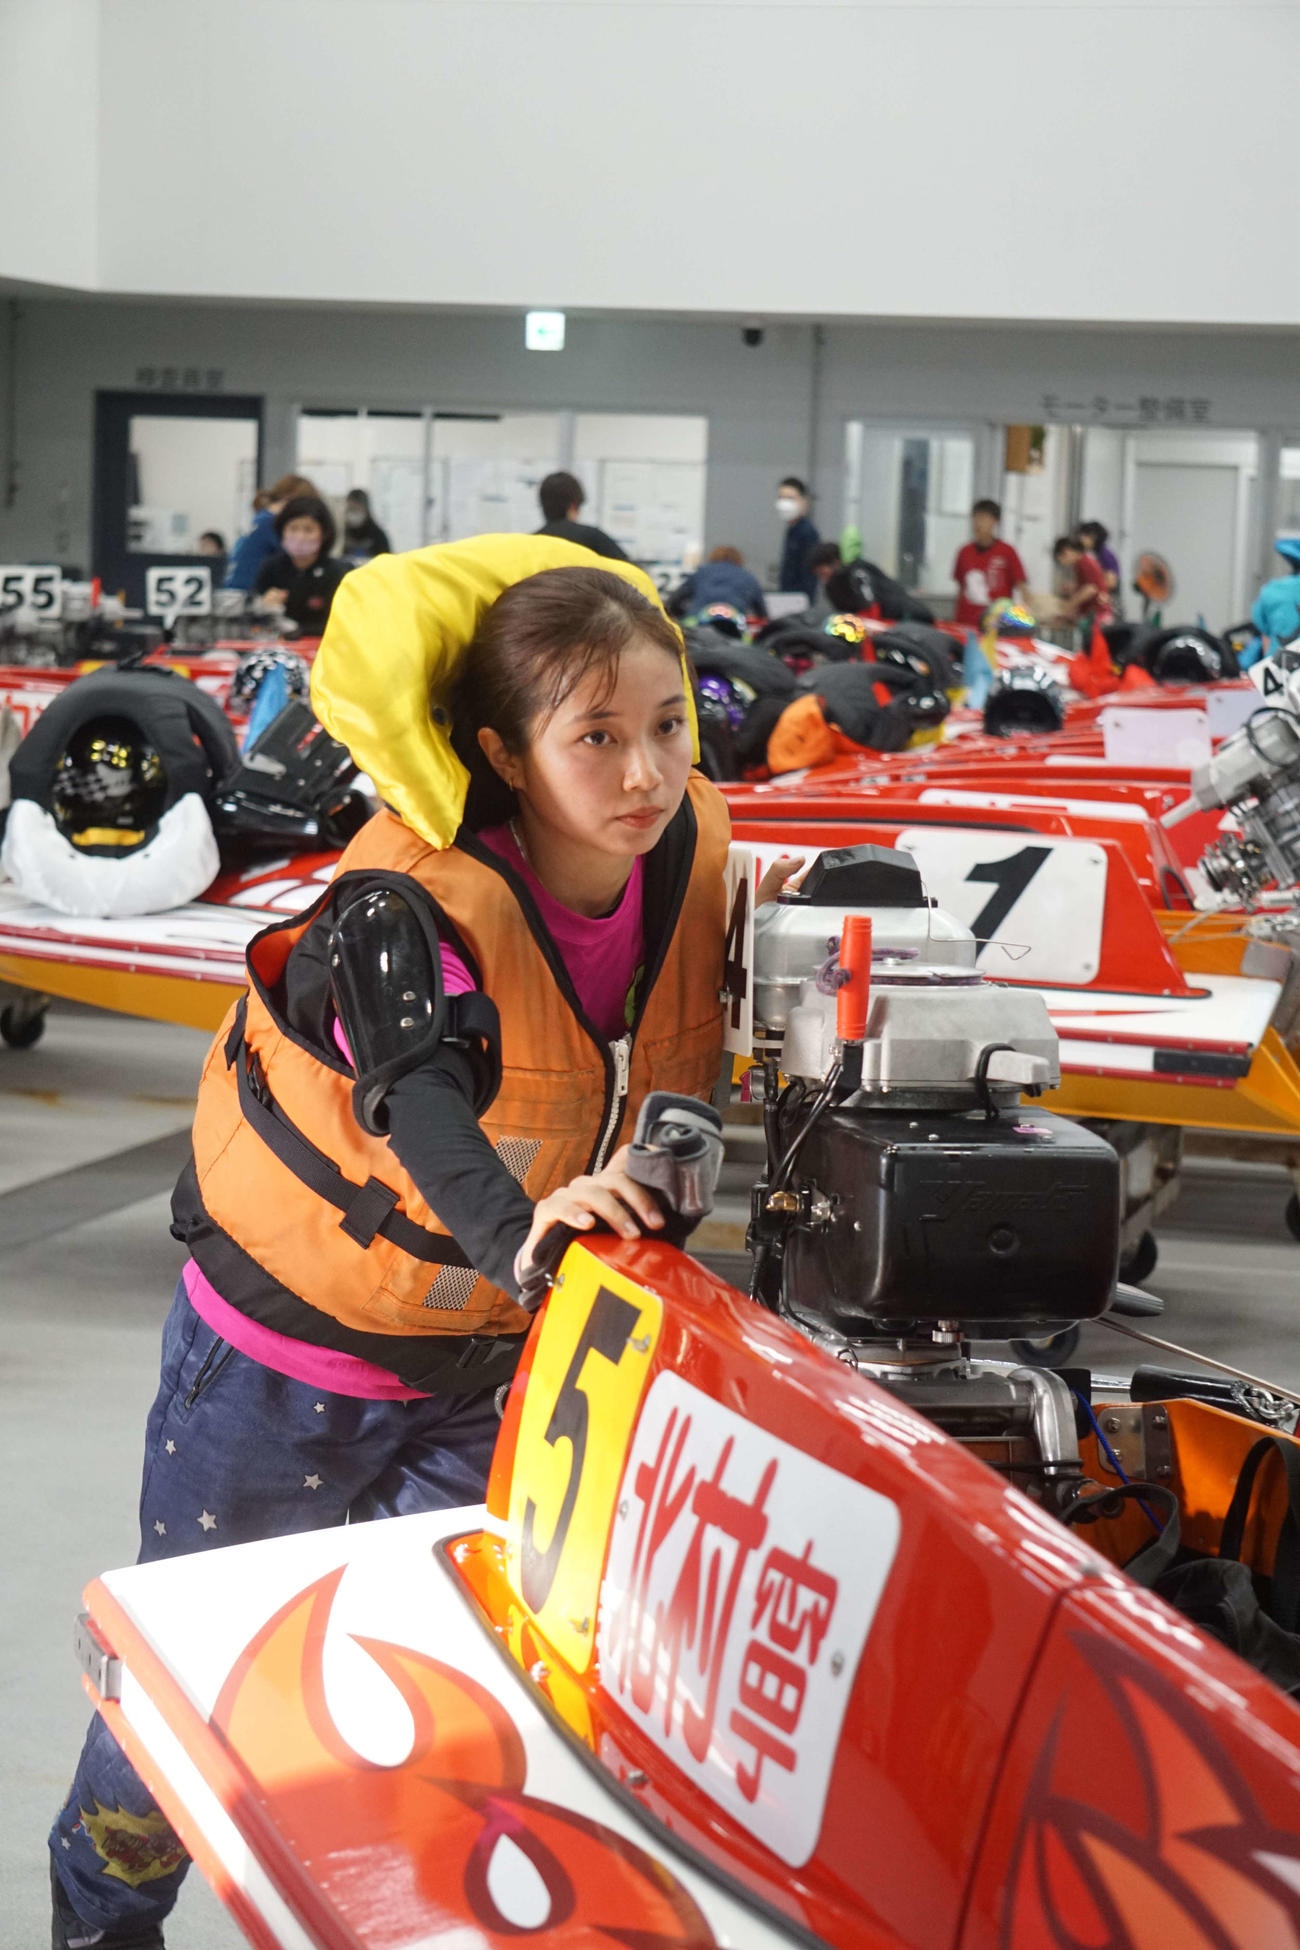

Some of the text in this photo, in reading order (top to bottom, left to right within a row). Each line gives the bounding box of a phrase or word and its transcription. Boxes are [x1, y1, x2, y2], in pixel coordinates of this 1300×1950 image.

[0, 576, 55, 611] 55
[156, 577, 204, 607] 52
[964, 845, 1055, 961] 1
[520, 1283, 642, 1615] 5
